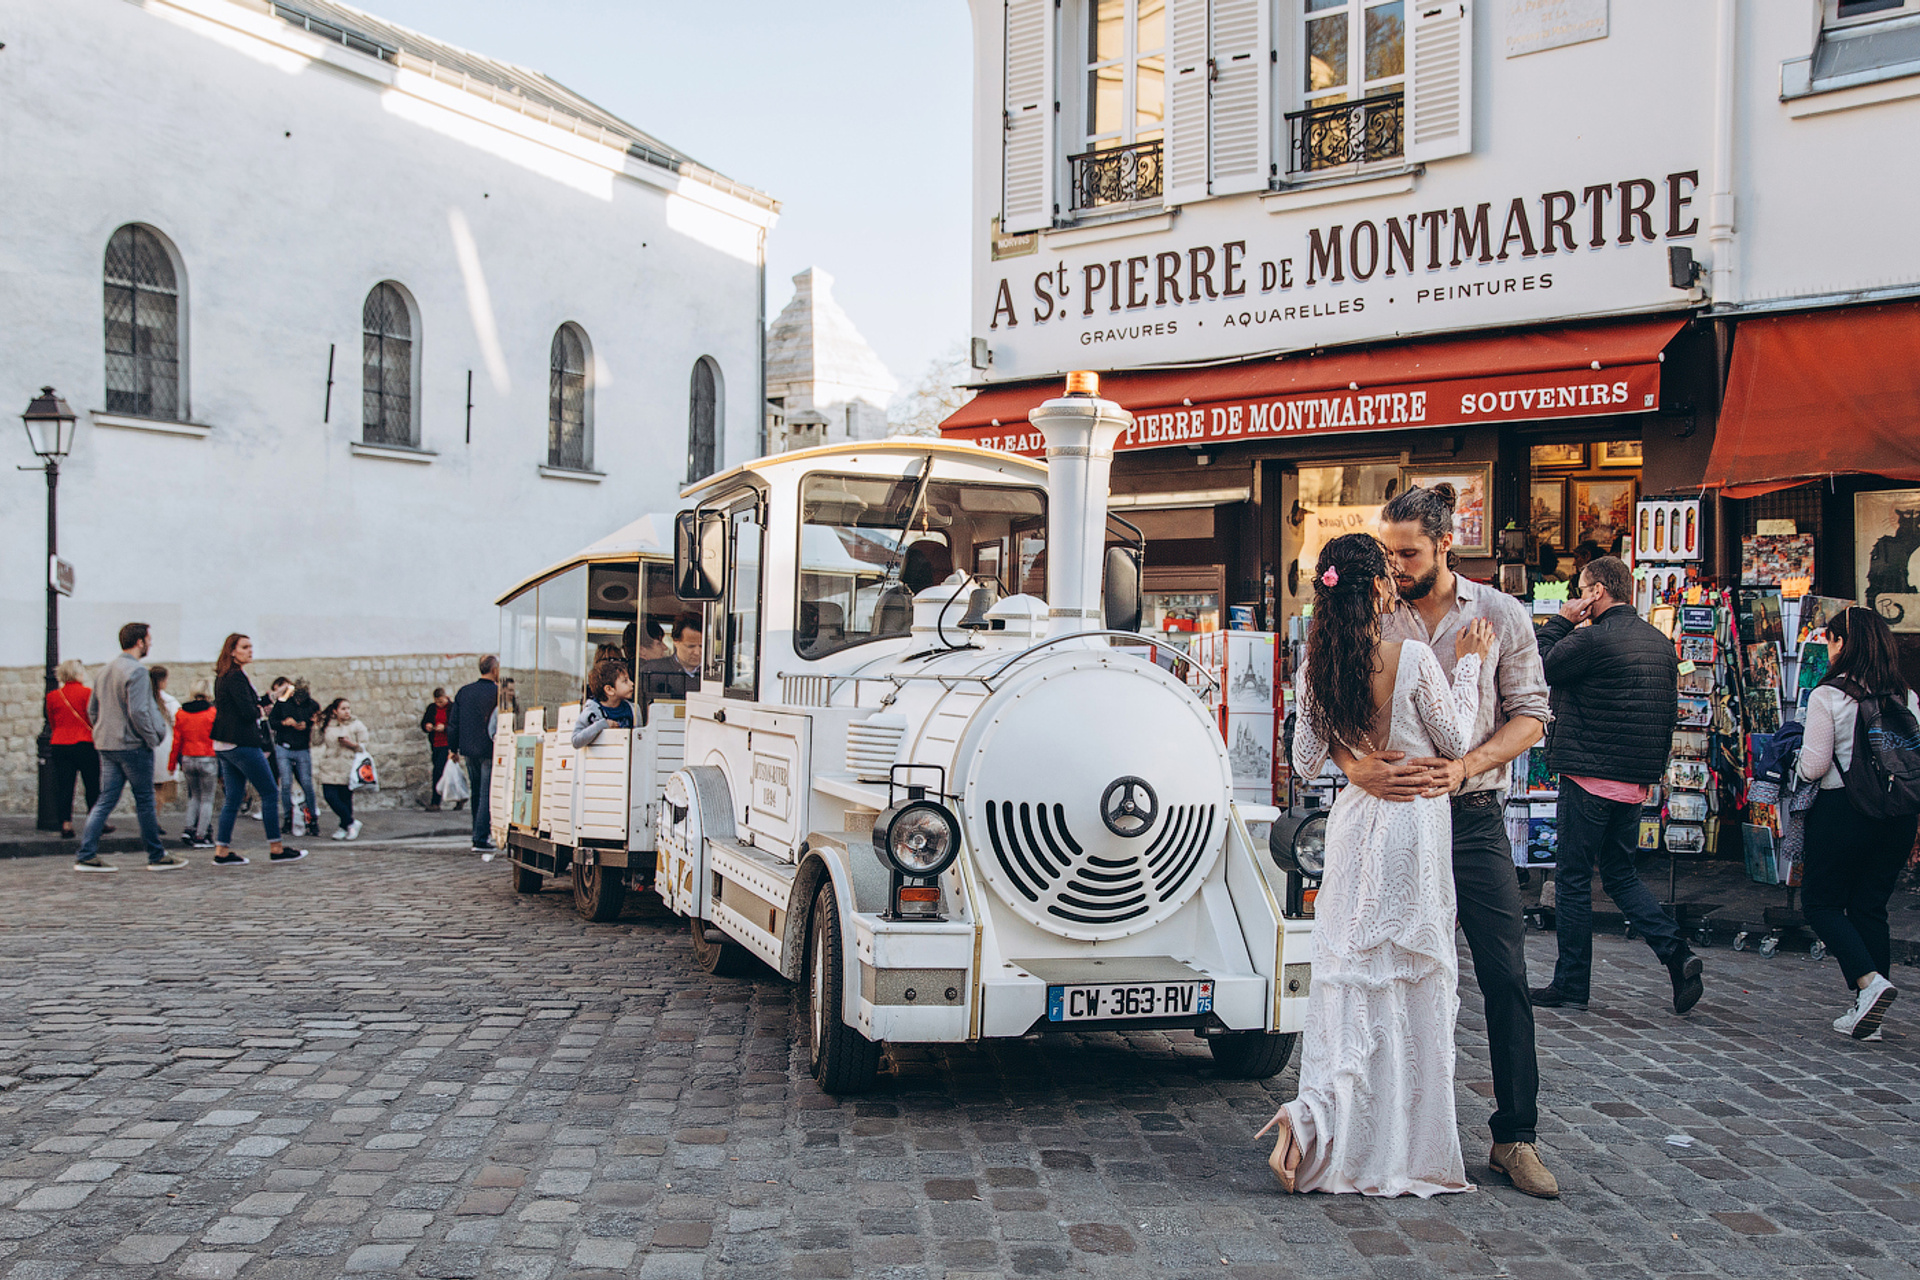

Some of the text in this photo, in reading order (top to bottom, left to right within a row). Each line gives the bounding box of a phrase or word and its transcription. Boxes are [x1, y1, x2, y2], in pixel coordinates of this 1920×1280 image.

[990, 278, 1018, 330] A
[1082, 240, 1247, 317] PIERRE
[1261, 258, 1294, 293] DE
[1306, 170, 1699, 287] MONTMARTRE
[1080, 273, 1553, 346] GRAVURES AQUARELLES PEINTURES
[1125, 409, 1205, 445] PIERRE
[1210, 406, 1243, 435] DE
[1247, 390, 1427, 433] MONTMARTRE
[1460, 381, 1629, 415] SOUVENIRS
[1198, 999, 1212, 1011] 75
